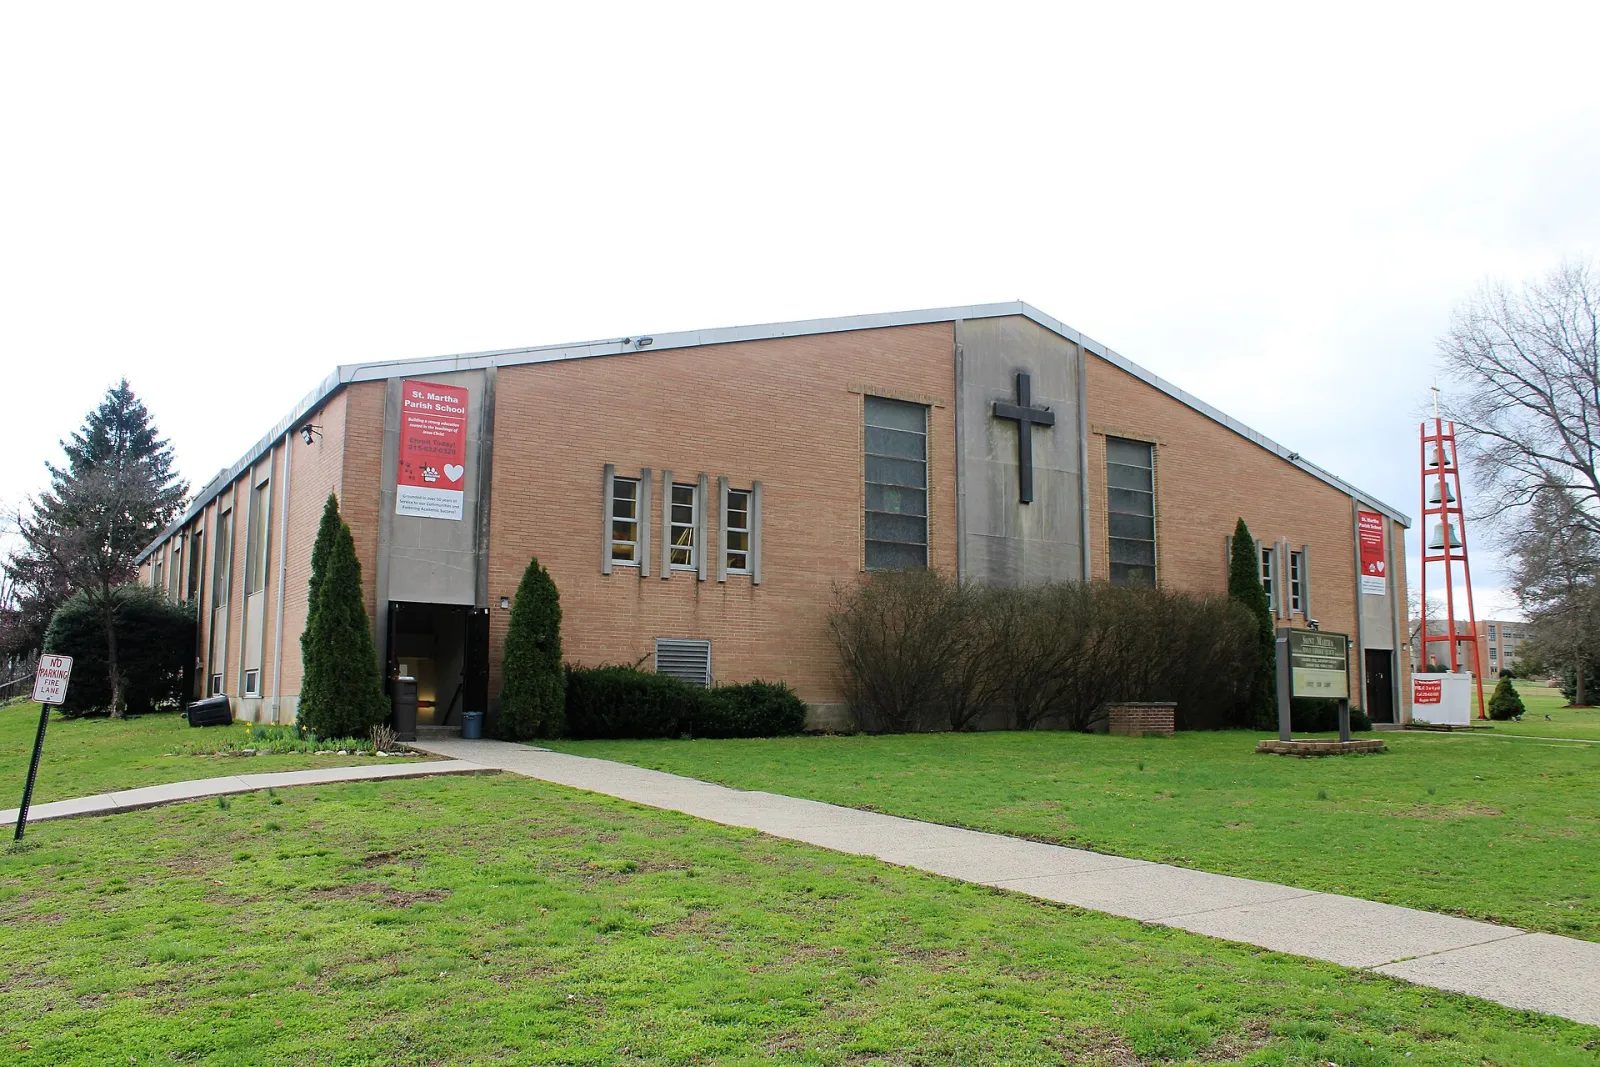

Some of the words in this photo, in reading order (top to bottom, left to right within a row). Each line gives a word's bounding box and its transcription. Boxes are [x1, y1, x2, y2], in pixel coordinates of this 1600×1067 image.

[412, 391, 424, 399] St.
[427, 393, 458, 403] Martha
[404, 400, 432, 409] Parish
[435, 404, 465, 414] School
[433, 440, 456, 448] Today!
[50, 658, 62, 668] NO
[39, 668, 68, 679] PARKING
